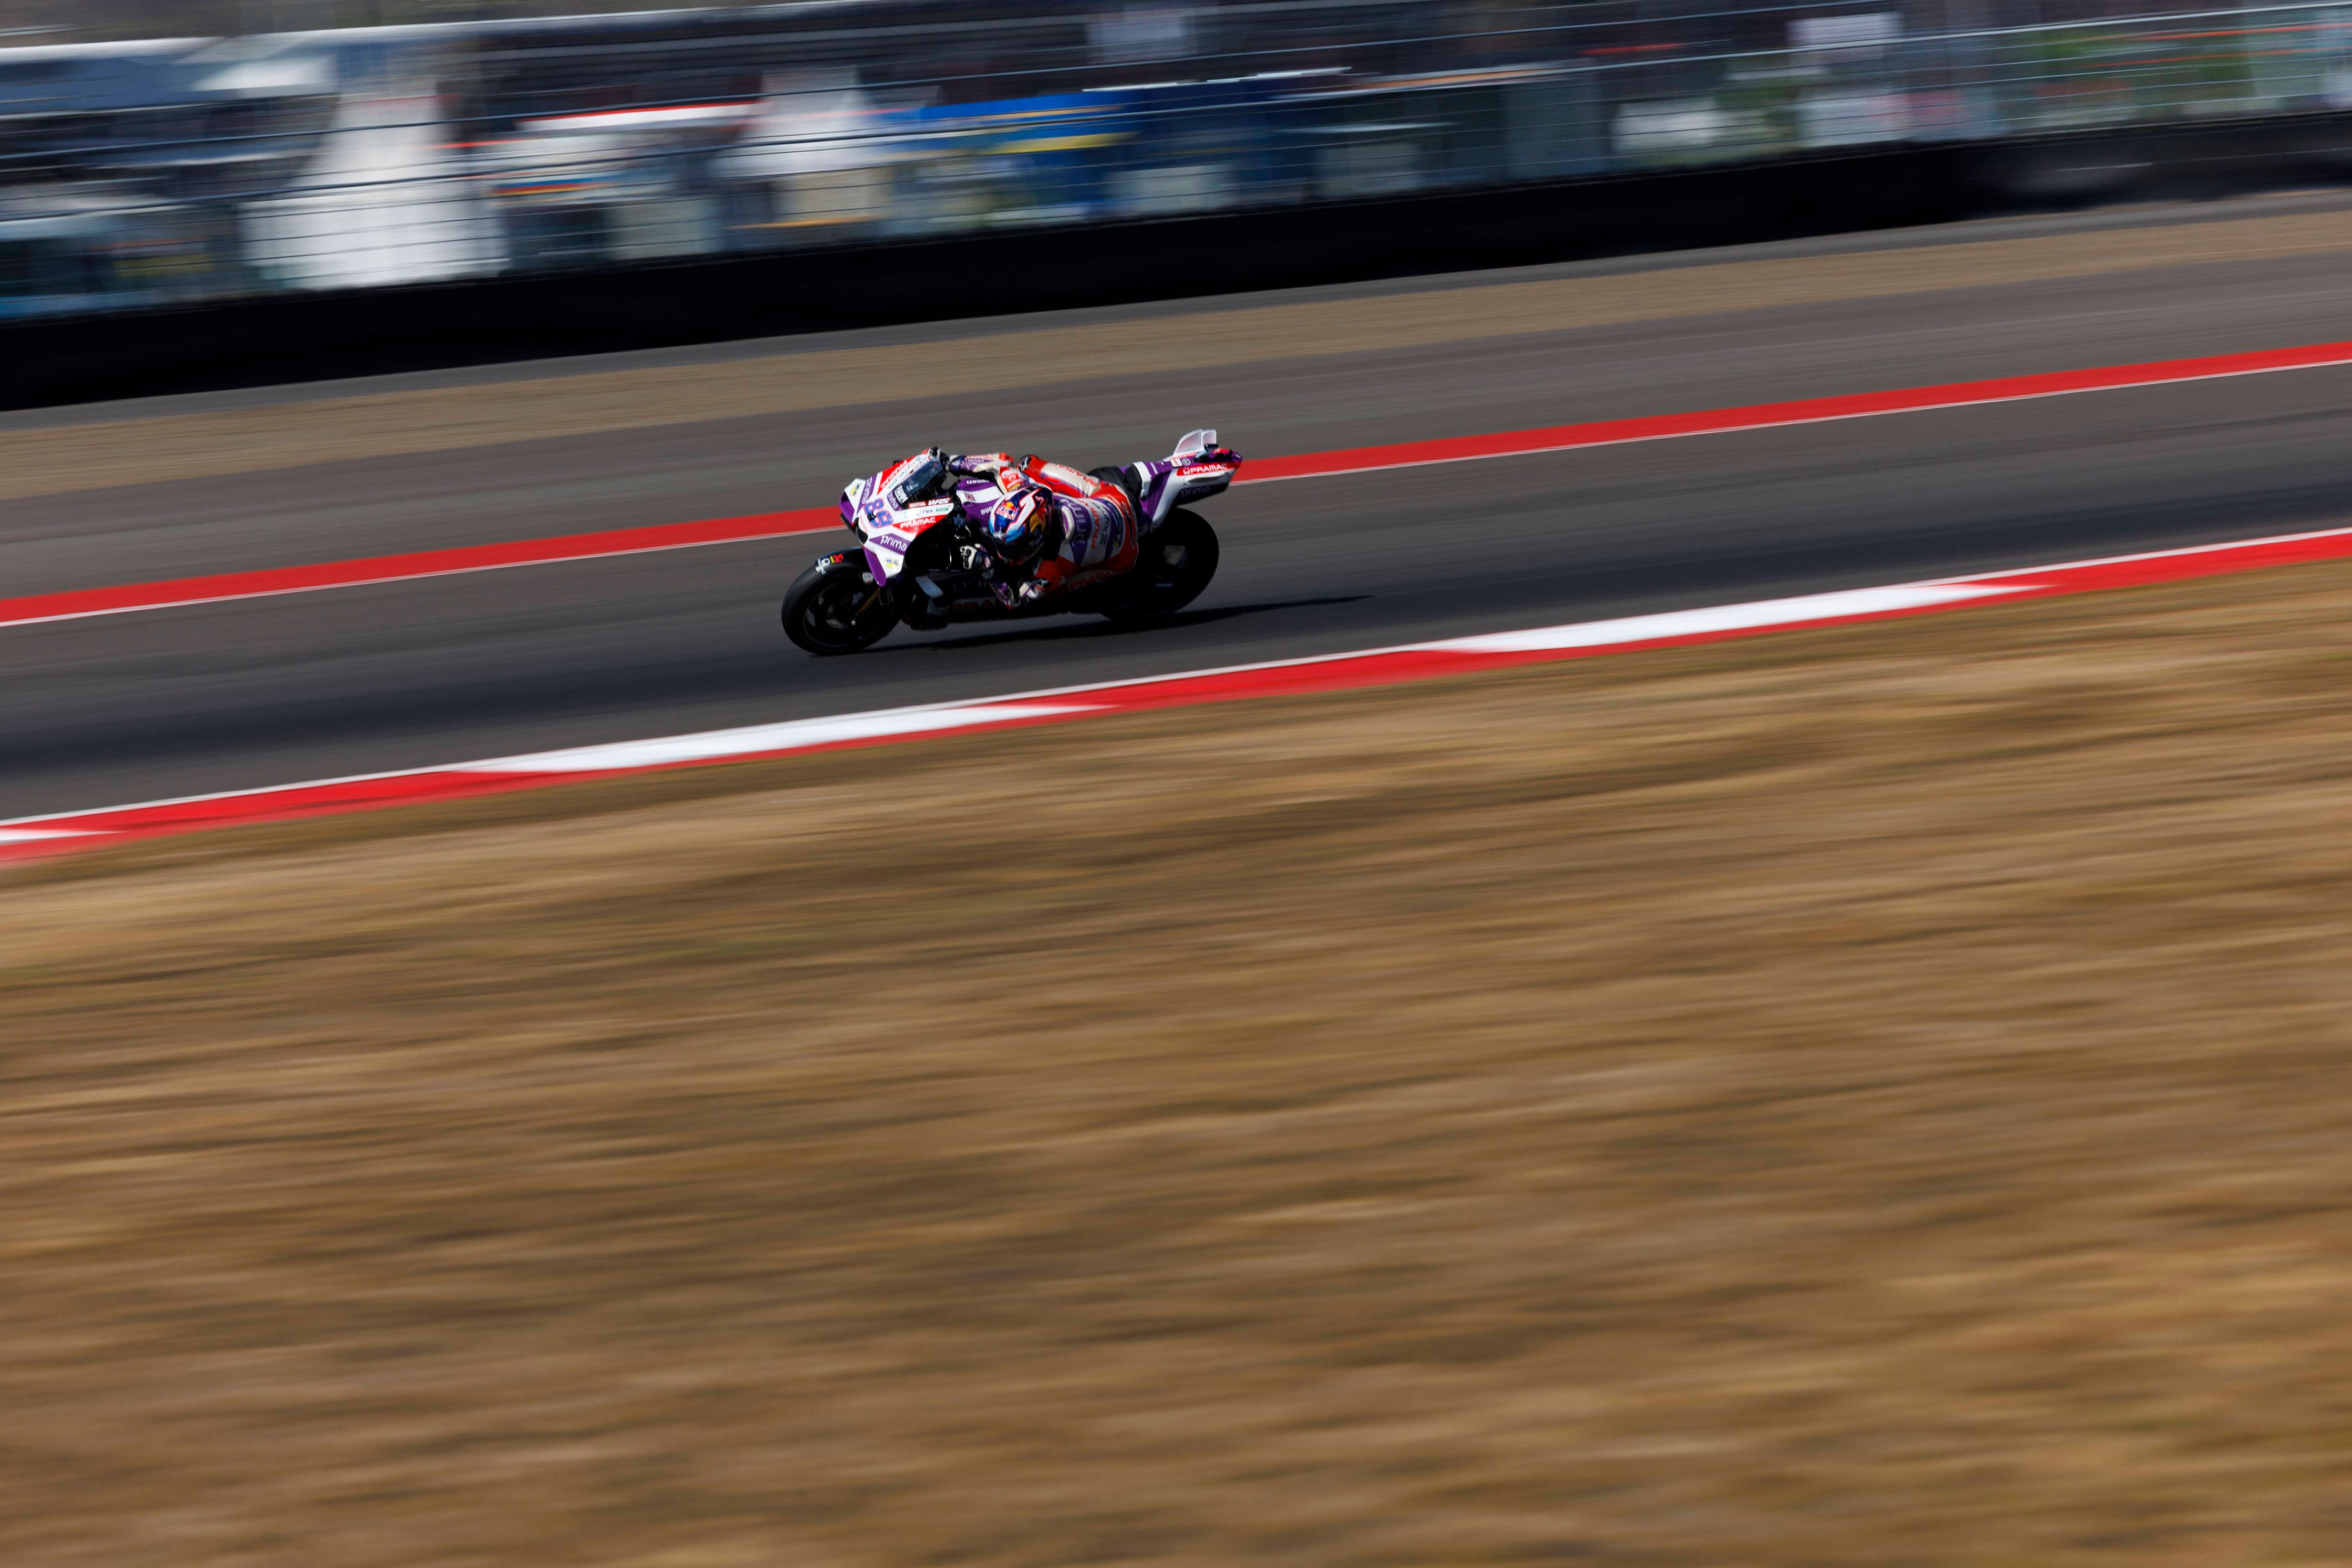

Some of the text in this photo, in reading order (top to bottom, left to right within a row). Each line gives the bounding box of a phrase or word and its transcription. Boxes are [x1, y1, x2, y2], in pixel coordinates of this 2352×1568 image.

[1190, 463, 1227, 474] PRAMAC
[1181, 486, 1210, 498] prima
[900, 517, 936, 529] PRAMAC
[880, 535, 907, 552] prima
